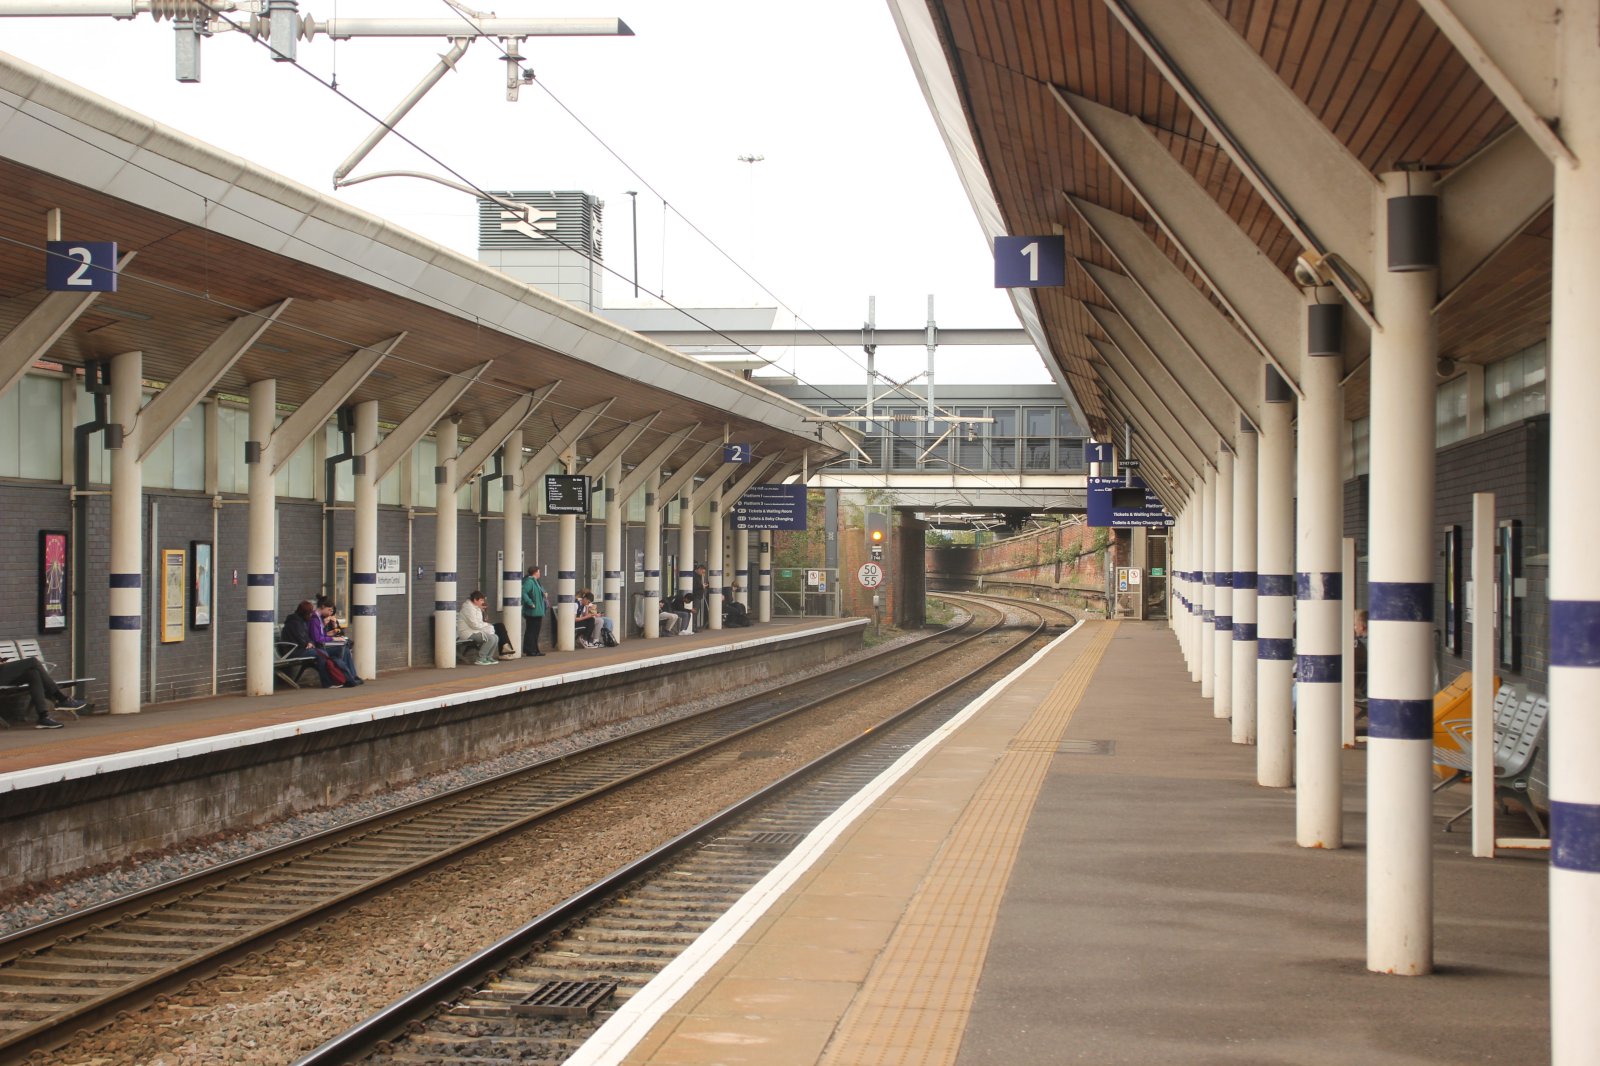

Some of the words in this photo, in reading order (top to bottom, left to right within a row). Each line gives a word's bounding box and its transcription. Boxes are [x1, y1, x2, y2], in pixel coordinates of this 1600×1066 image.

[67, 247, 92, 285] 2
[1020, 242, 1038, 280] 1
[732, 446, 742, 460] 2
[1095, 445, 1103, 460] 1
[864, 565, 876, 574] 50
[864, 577, 876, 586] 55
